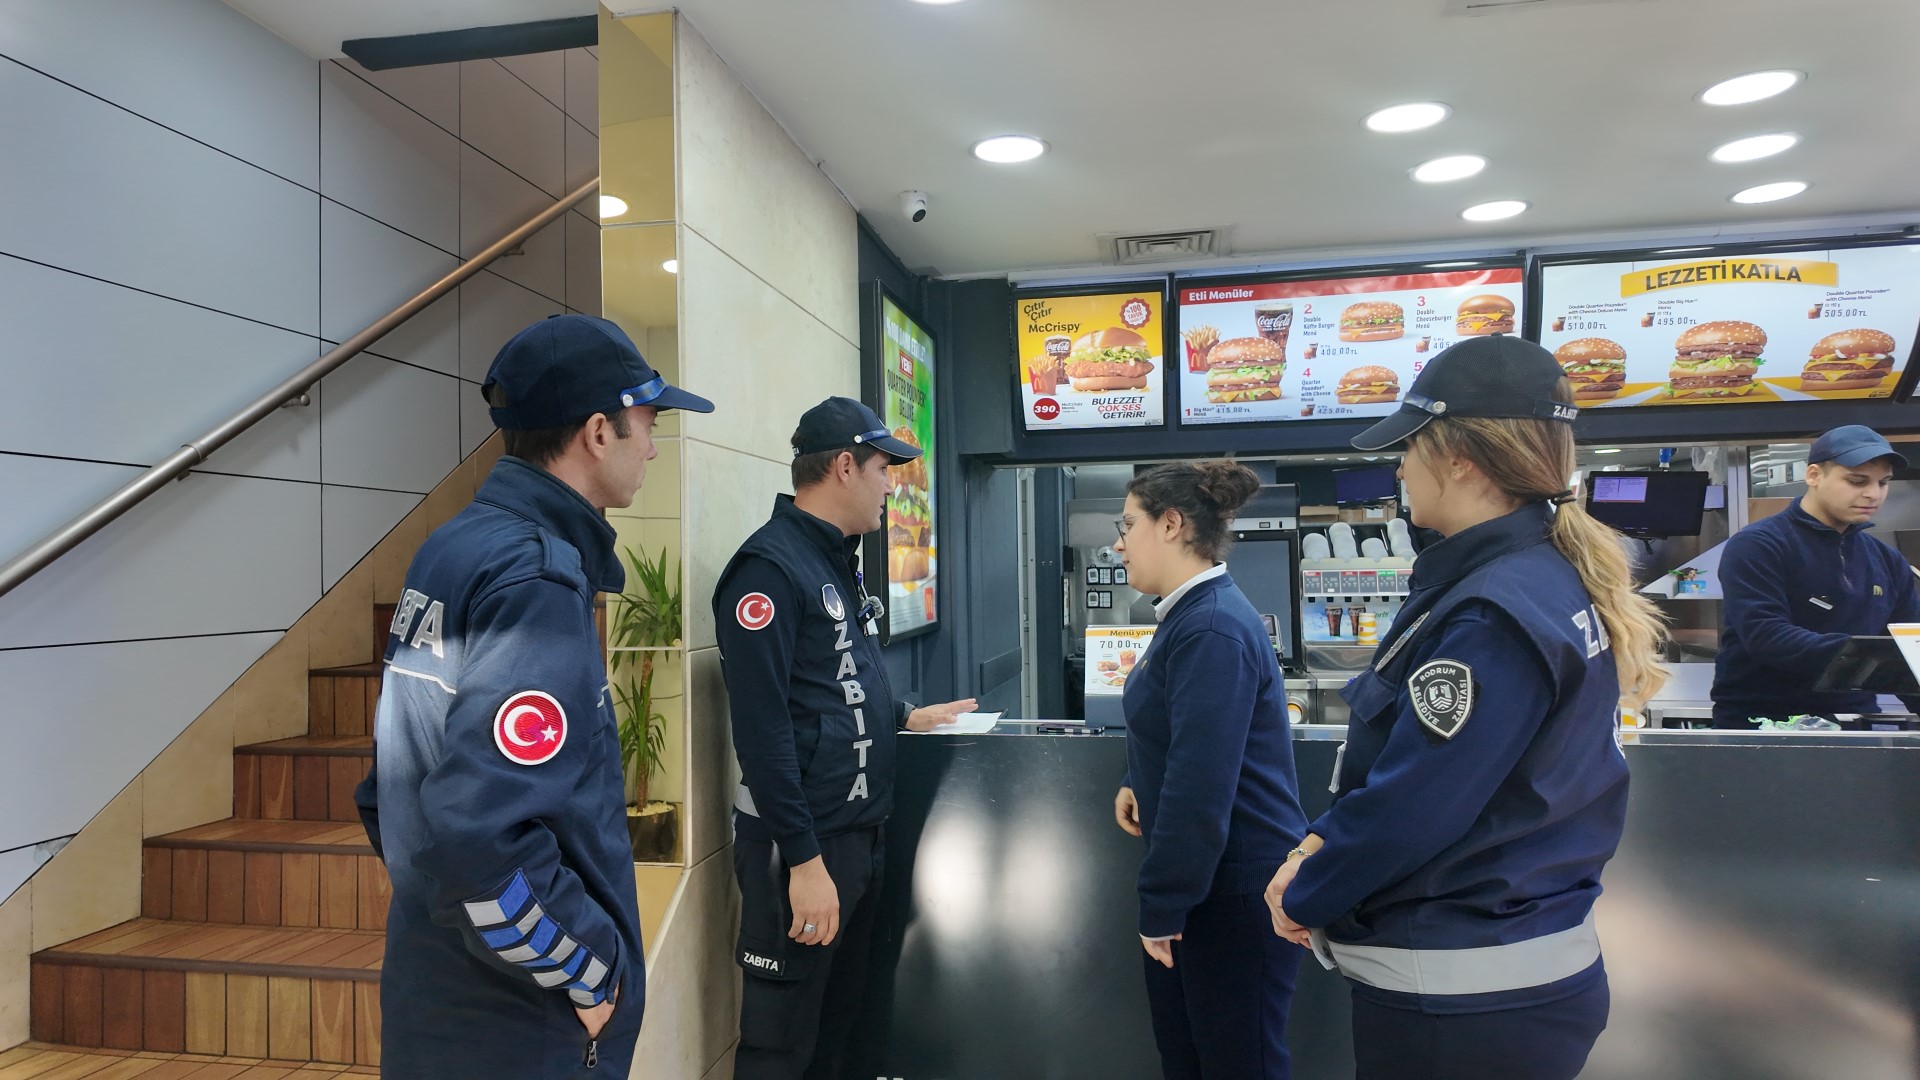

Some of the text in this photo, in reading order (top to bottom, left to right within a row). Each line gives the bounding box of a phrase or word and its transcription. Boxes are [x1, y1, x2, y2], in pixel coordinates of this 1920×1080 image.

[1645, 259, 1802, 291] LEZZETİ KATLA
[1189, 288, 1254, 302] Etli Menüler
[1417, 295, 1426, 307] 3
[1023, 301, 1045, 317] Çıtır
[1030, 307, 1052, 323] Çıtır
[1303, 303, 1312, 314] 2
[1028, 321, 1080, 334] McCrispy
[1302, 367, 1312, 377] 4
[1414, 361, 1423, 372] 5
[1091, 396, 1145, 406] BU LEZZET
[1097, 404, 1120, 414] ÇOK
[1184, 408, 1191, 417] 1
[1419, 667, 1456, 682] BODRUM
[1451, 679, 1468, 722] ZABITASI
[834, 620, 873, 802] ZABITA
[743, 951, 779, 972] ZABITA
